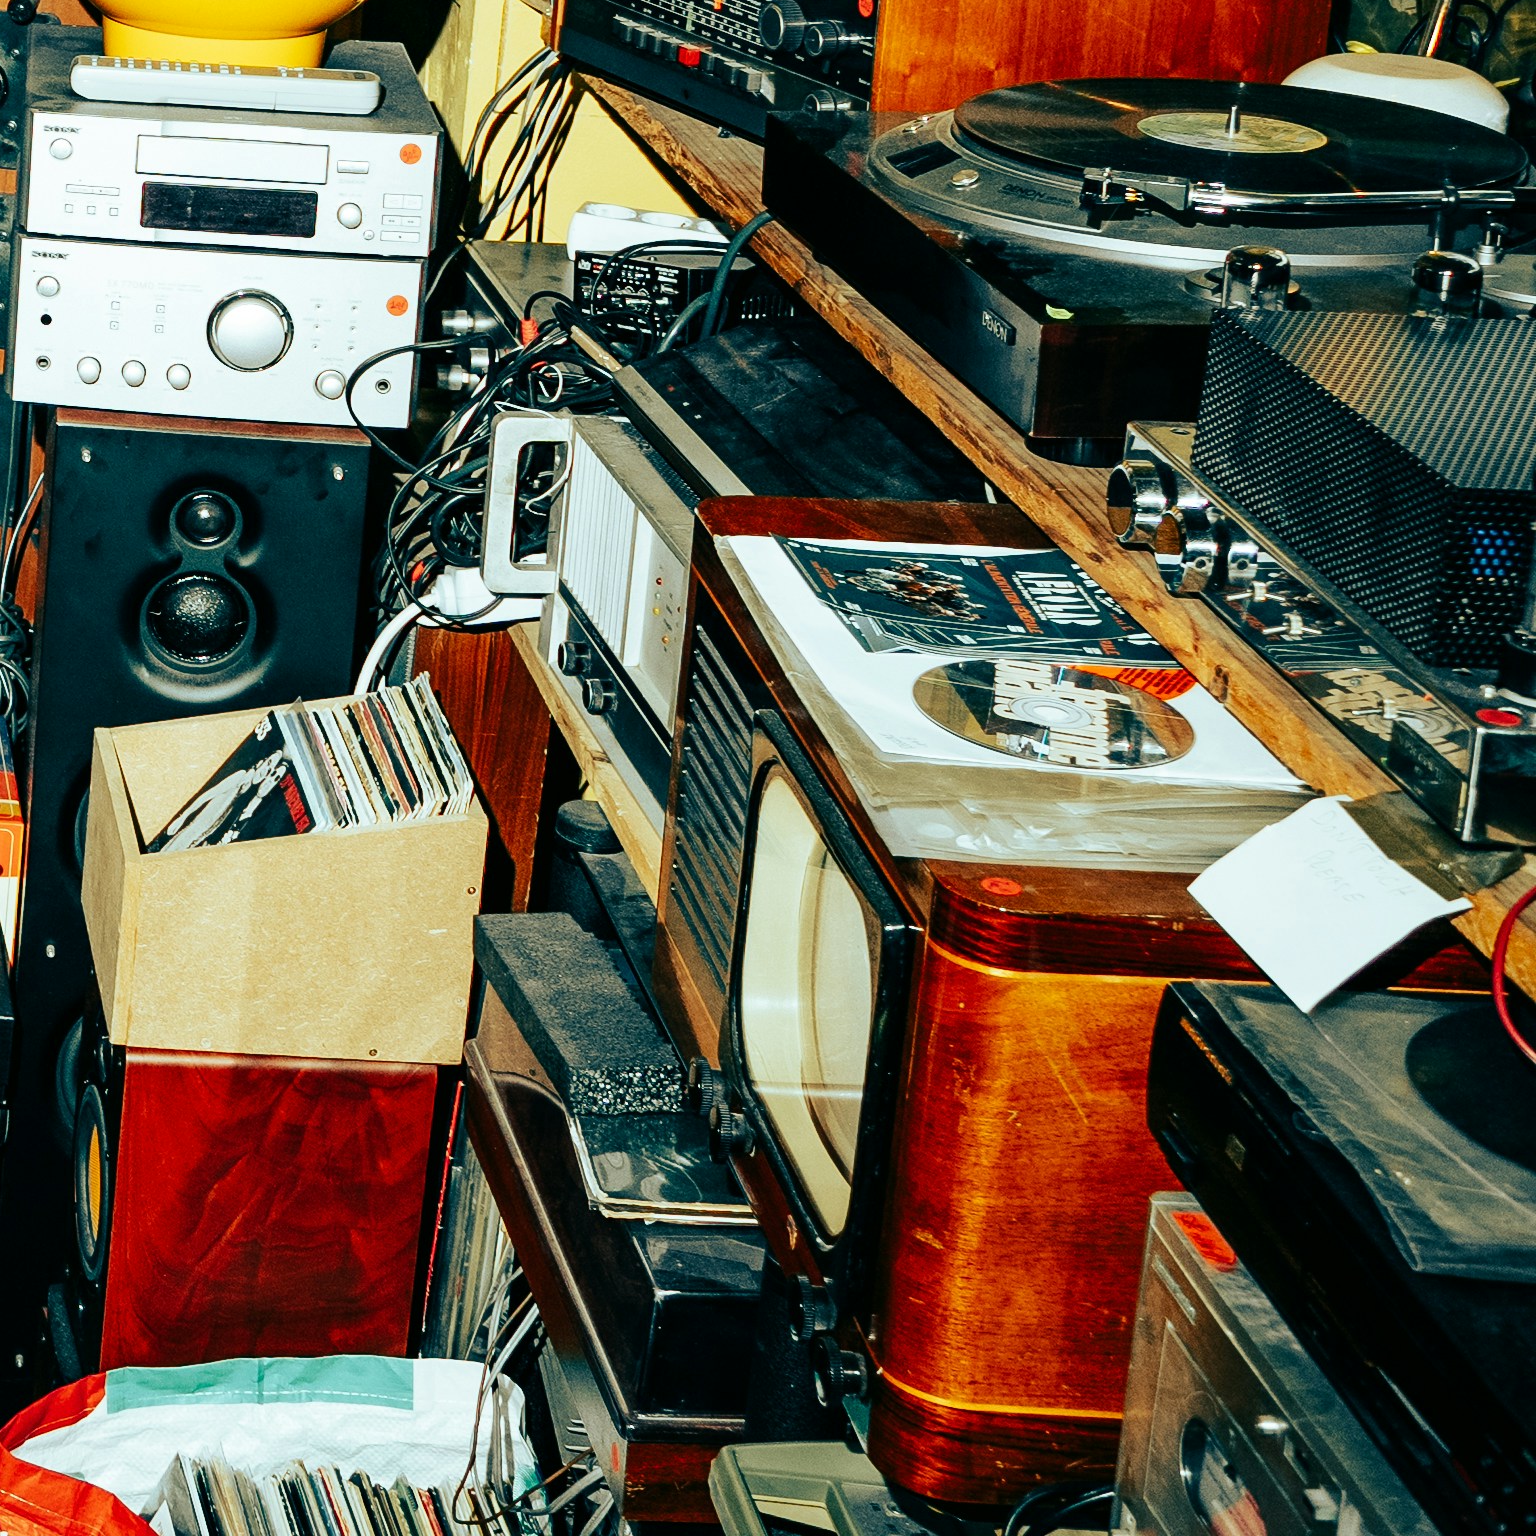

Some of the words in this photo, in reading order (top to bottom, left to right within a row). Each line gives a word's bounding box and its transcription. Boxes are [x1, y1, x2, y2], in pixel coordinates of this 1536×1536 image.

[43, 125, 83, 134] SONY
[1002, 183, 1047, 199] DENON
[31, 251, 70, 260] SONY
[982, 311, 1008, 342] DENON
[1015, 571, 1103, 626] AFROLAB
[1305, 850, 1365, 905] PLEASE
